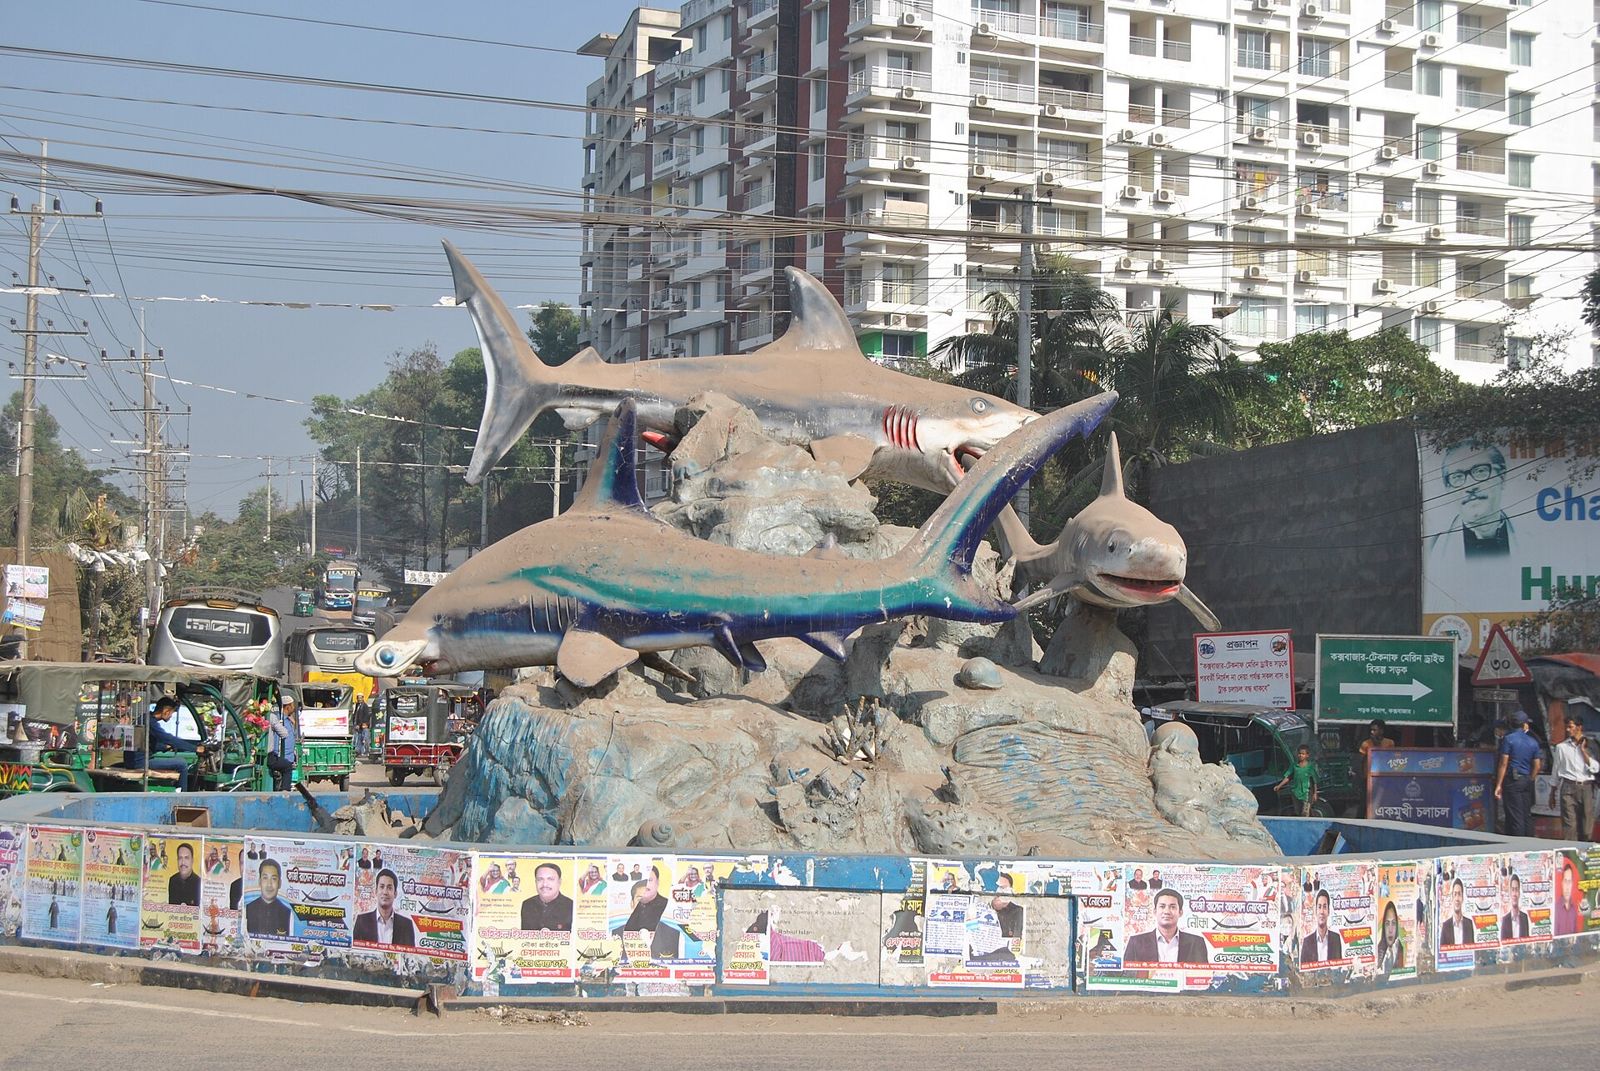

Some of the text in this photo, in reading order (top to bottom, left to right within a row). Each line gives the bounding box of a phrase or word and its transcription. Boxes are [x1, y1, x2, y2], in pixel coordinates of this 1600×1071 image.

[1226, 640, 1258, 649] প্রজ্ঞাপন
[1401, 652, 1421, 663] মেরিন
[1424, 653, 1445, 664] ড্রাইভ
[1366, 663, 1408, 676] বিকল্প সড়ক
[1490, 659, 1510, 670] ৩০
[1375, 803, 1450, 820] একমুখী চলাচল
[294, 905, 344, 917] ভাইস চেয়ারম্যান
[1247, 902, 1268, 914] নোবেল
[1187, 914, 1209, 929] নৌকা
[1211, 933, 1266, 944] ভাইস চেয়ারম্যান
[1214, 954, 1248, 963] দেখতে
